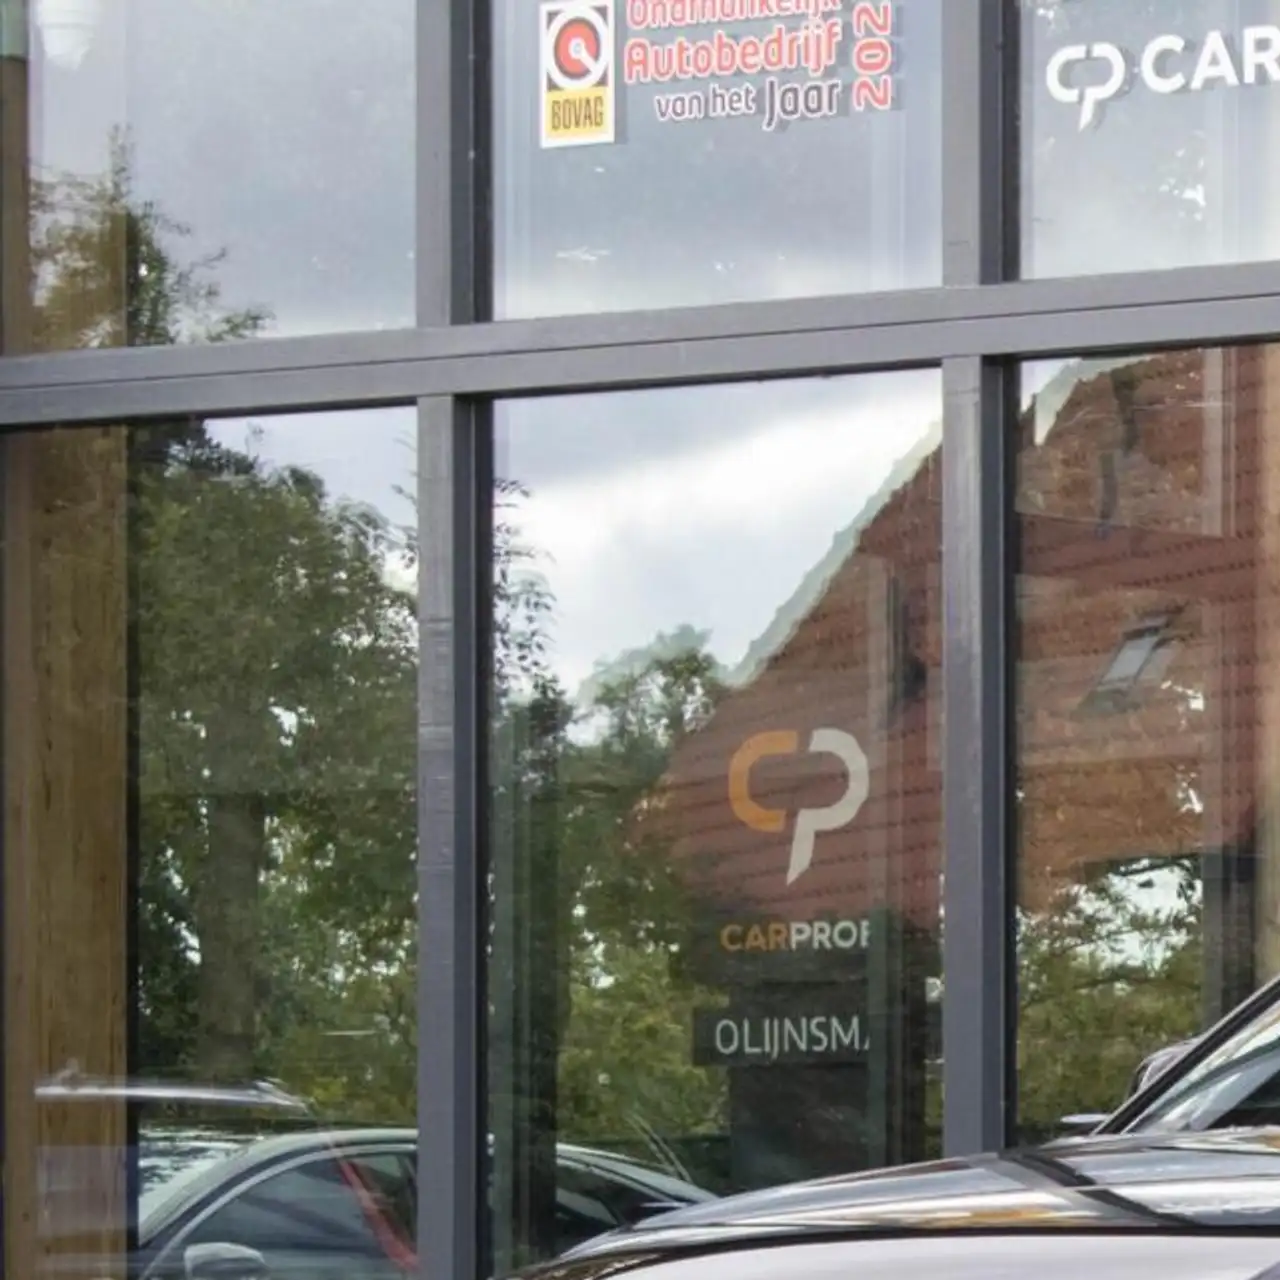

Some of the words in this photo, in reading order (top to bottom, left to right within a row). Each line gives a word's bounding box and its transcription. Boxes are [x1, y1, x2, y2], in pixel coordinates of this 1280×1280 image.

[625, 20, 841, 83] Autobedrijf
[551, 96, 605, 132] BOVAG
[657, 95, 703, 120] van
[711, 84, 755, 115] het
[714, 1014, 870, 1060] OLIJNSM
